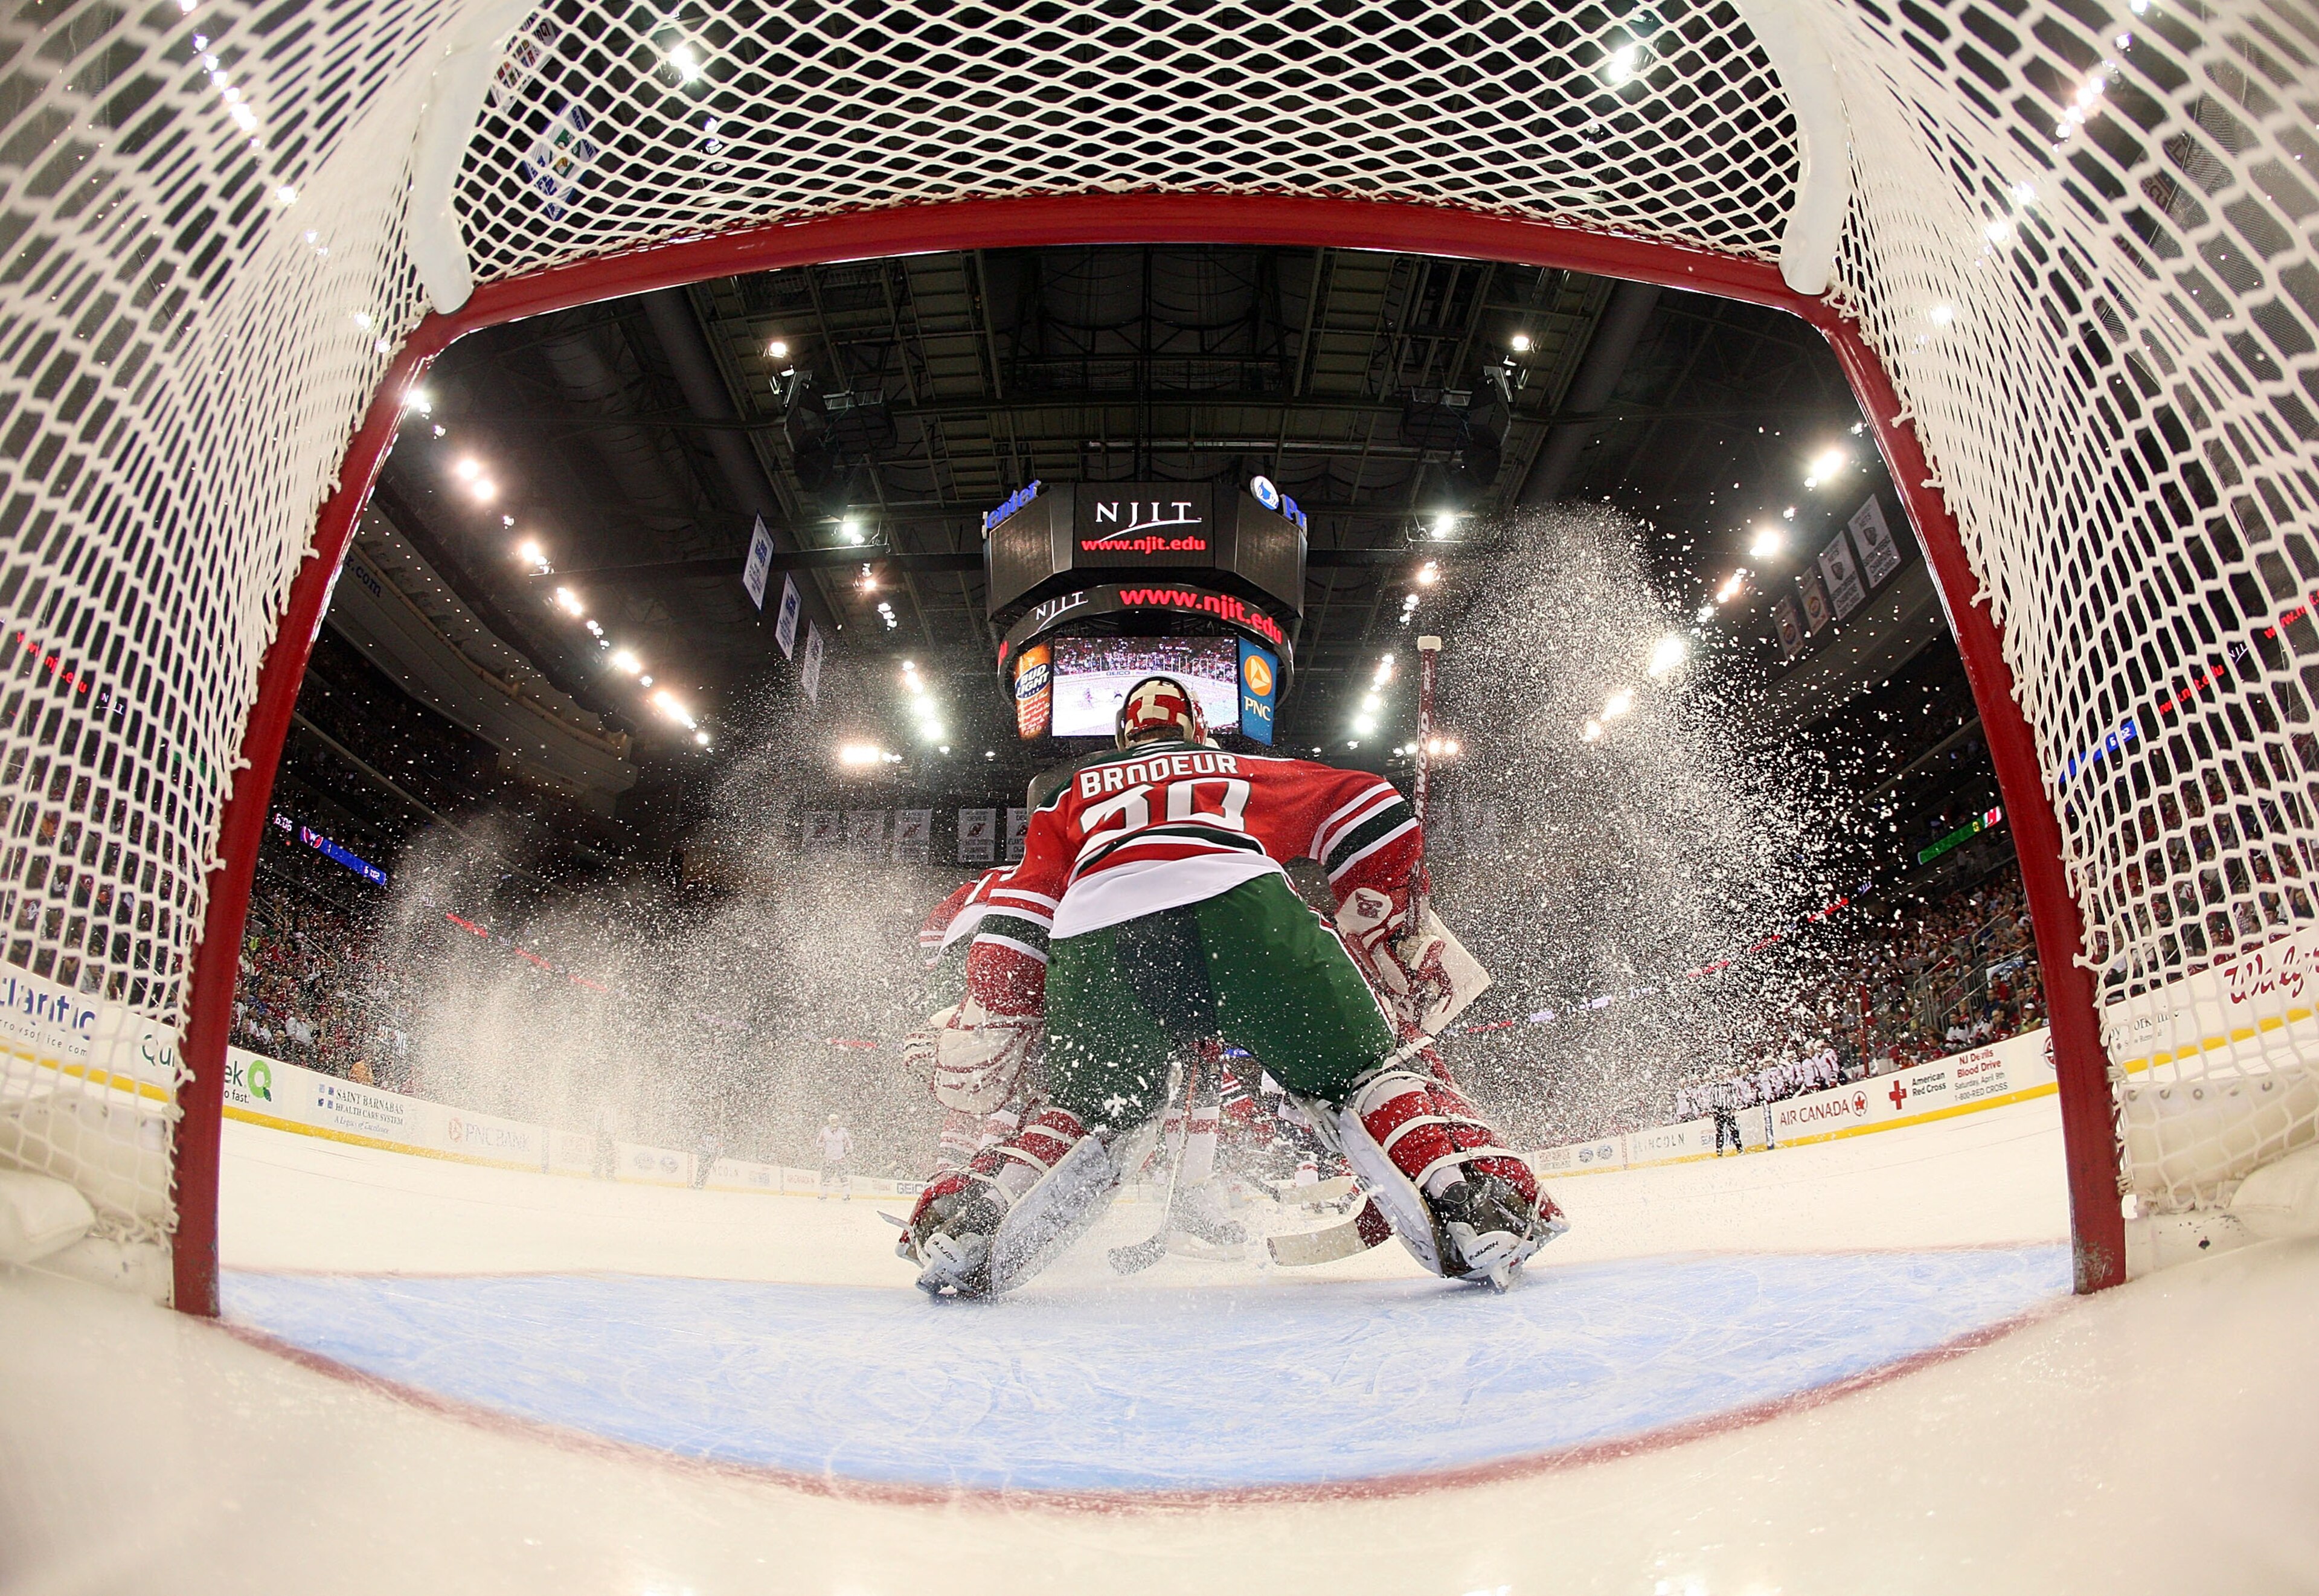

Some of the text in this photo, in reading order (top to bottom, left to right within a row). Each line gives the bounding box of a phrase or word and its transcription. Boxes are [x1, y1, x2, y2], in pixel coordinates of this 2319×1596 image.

[982, 479, 1041, 539] enter
[1095, 501, 1193, 527] NJIT
[1081, 536, 1206, 553] www.njit.edu
[1036, 591, 1084, 621] NJIT
[1120, 589, 1283, 644] www.njit.edu
[1017, 671, 1050, 695] LIGHT
[1020, 664, 1047, 687] BUD
[1244, 695, 1271, 721] PNC
[1079, 754, 1239, 799] BRODEUR
[1957, 1060, 2001, 1078] Blood Drive
[1959, 1056, 1968, 1065] NJ
[1912, 1072, 1945, 1086] American
[1913, 1082, 1946, 1097] Red Cross
[1981, 1073, 1994, 1085] April
[1986, 1082, 2008, 1094] CROSS
[336, 1089, 404, 1115] SAINT BARNABAS
[1780, 1099, 1850, 1126] AIR CANADA
[336, 1103, 403, 1126] HEALTH CARE SYSTEM
